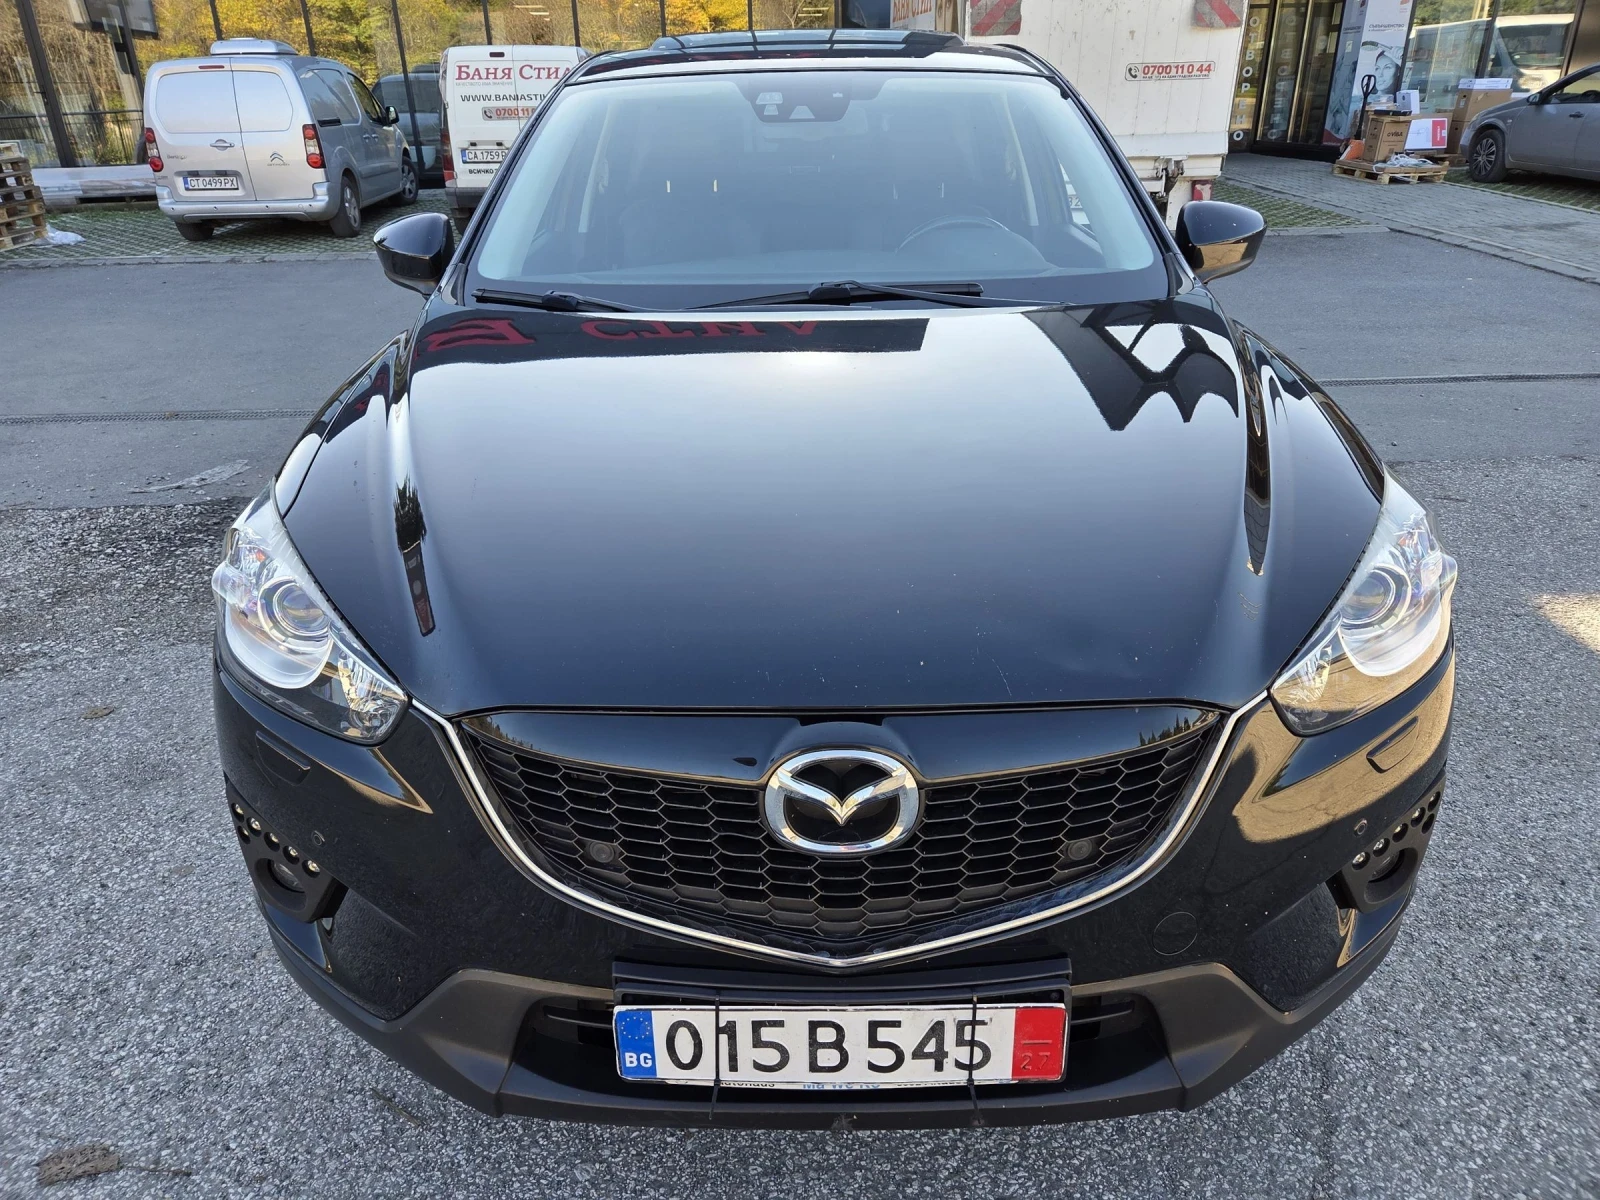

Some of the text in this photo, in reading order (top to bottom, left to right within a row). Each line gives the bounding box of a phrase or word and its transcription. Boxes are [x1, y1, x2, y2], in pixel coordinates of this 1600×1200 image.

[1142, 63, 1212, 76] 0700 11 0 44
[1233, 16, 1260, 140] ОТВОРЕНО
[495, 107, 519, 116] 0700
[521, 107, 529, 116] 11
[481, 150, 500, 160] 1759
[190, 178, 236, 188] CT 0499 PX
[625, 1053, 653, 1068] BG
[1020, 1053, 1051, 1070] 27
